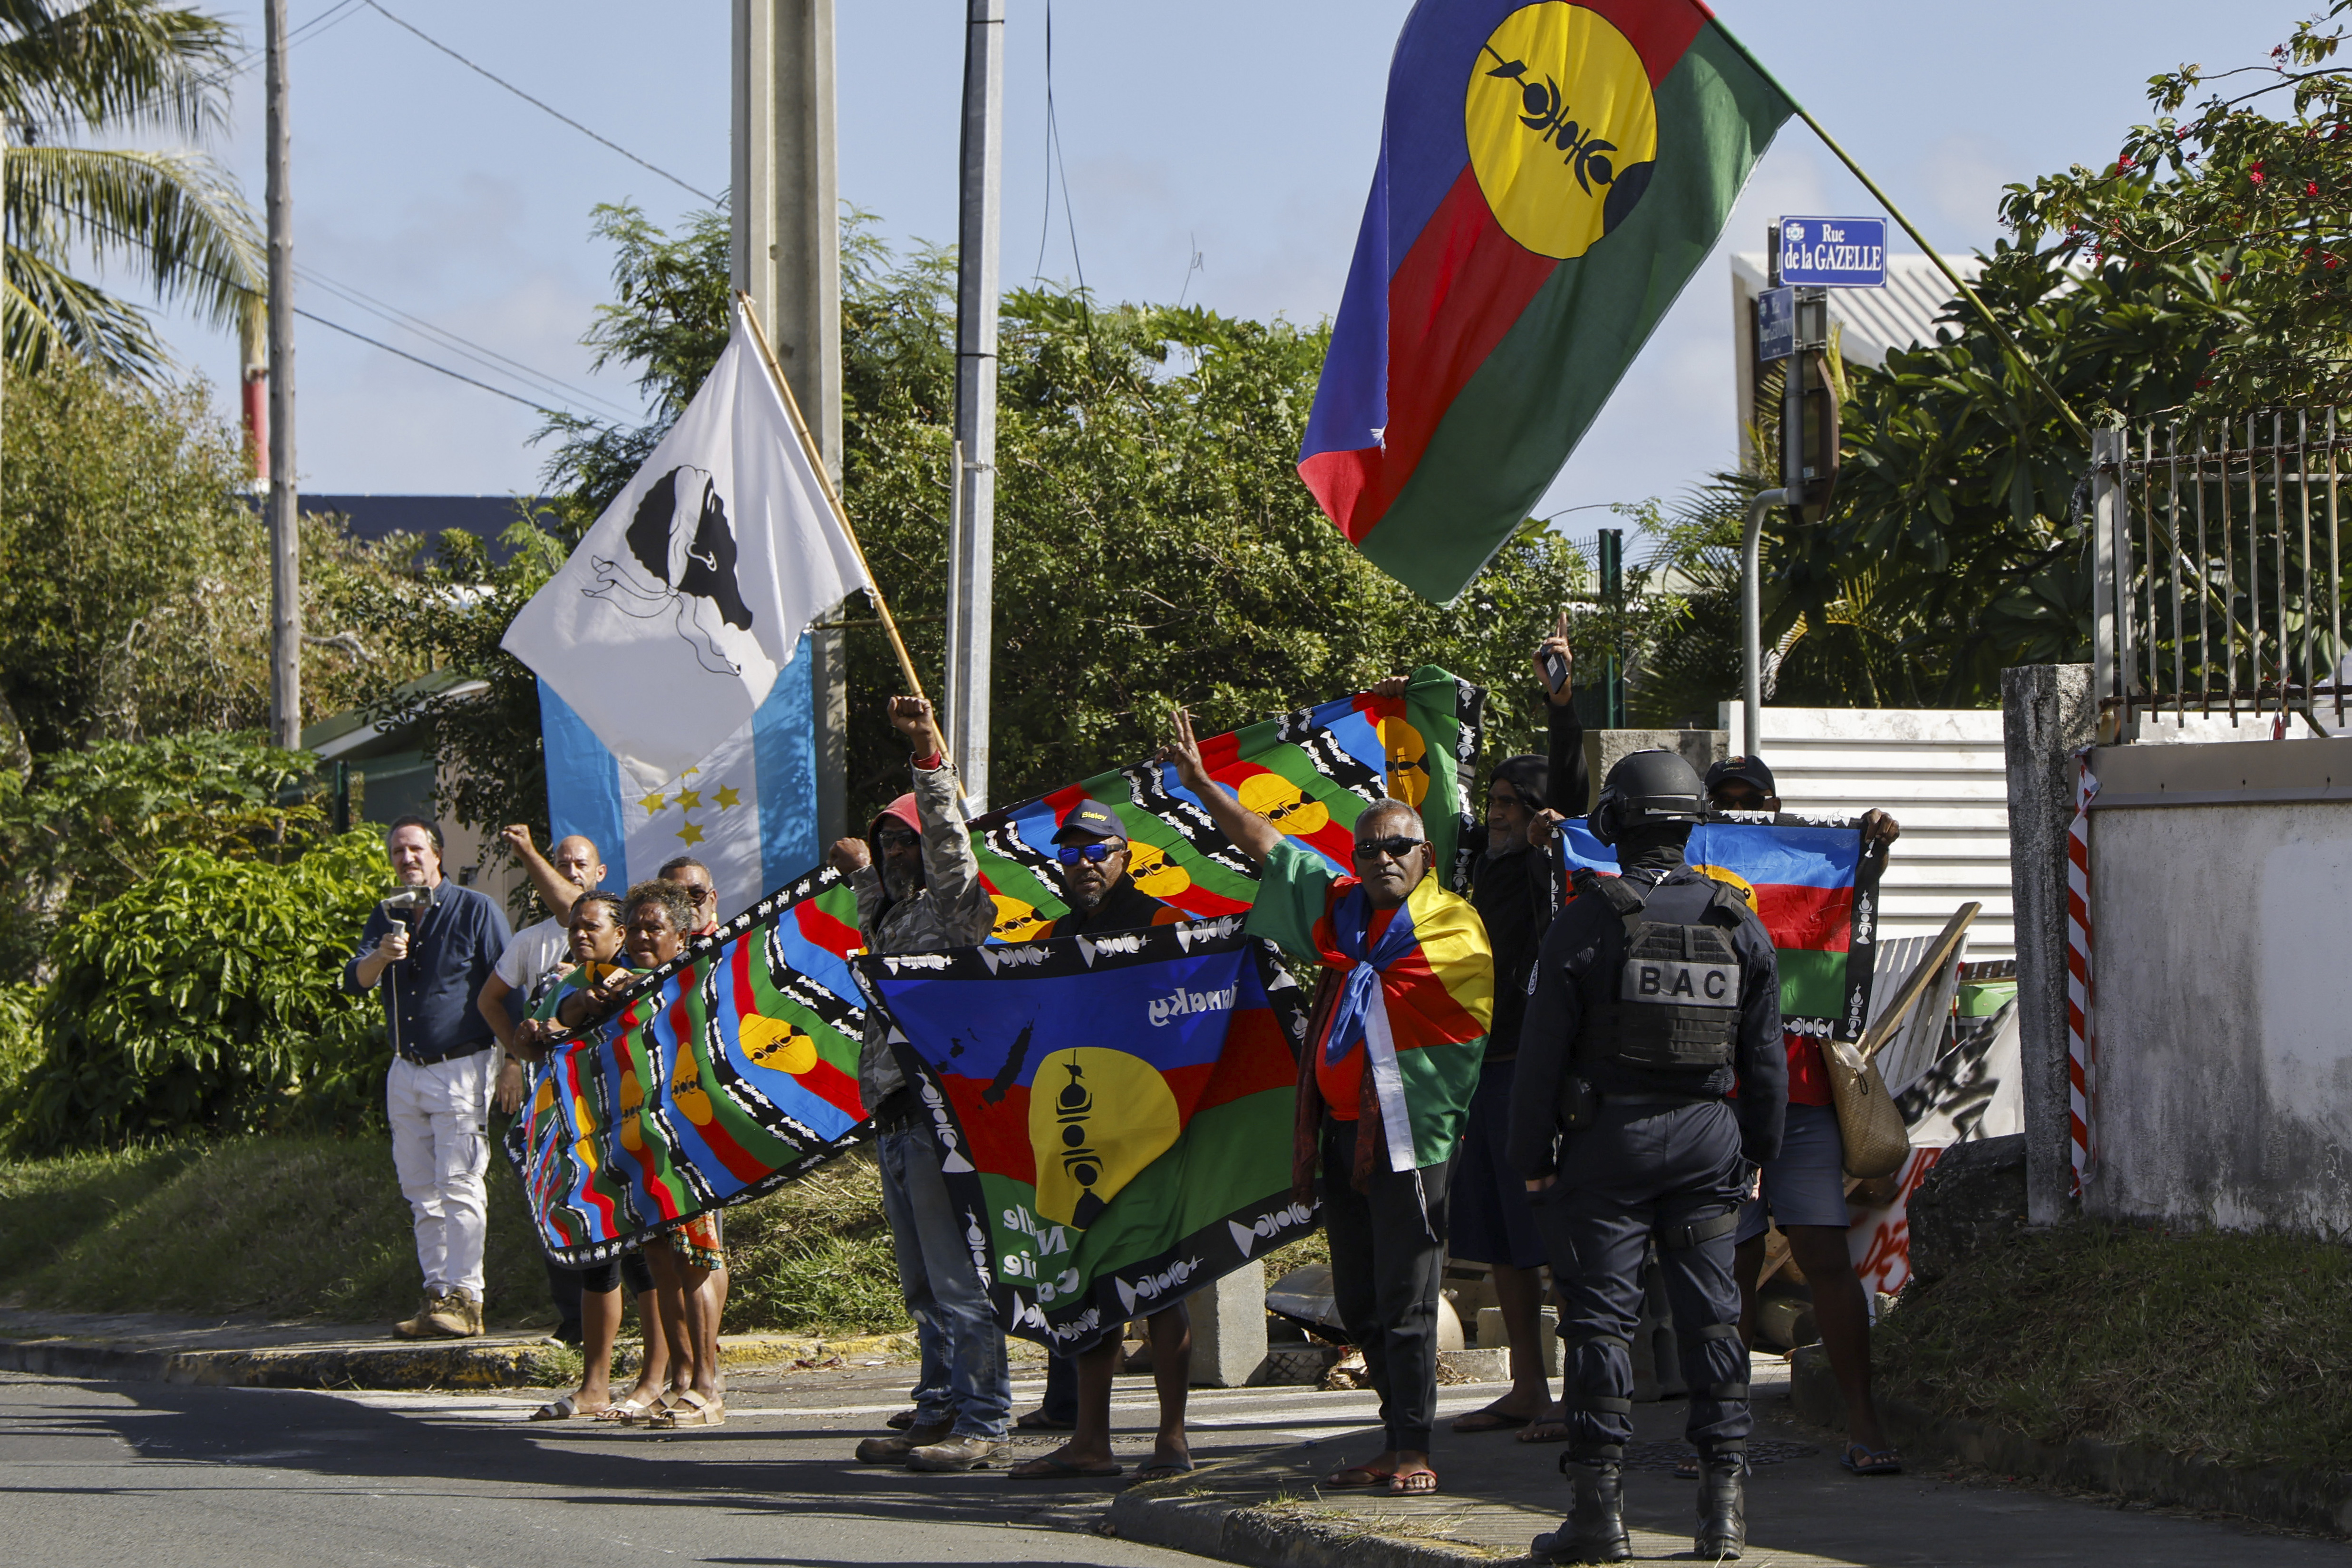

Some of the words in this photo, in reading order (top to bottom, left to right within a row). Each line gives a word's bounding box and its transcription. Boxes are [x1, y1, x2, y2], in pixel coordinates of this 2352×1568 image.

[1822, 224, 1845, 242] Rue
[1785, 243, 1799, 270] de
[1801, 243, 1813, 270] la
[1815, 244, 1882, 271] GAZELLE
[1081, 811, 1108, 822] Bisley
[1639, 966, 1726, 999] BAC
